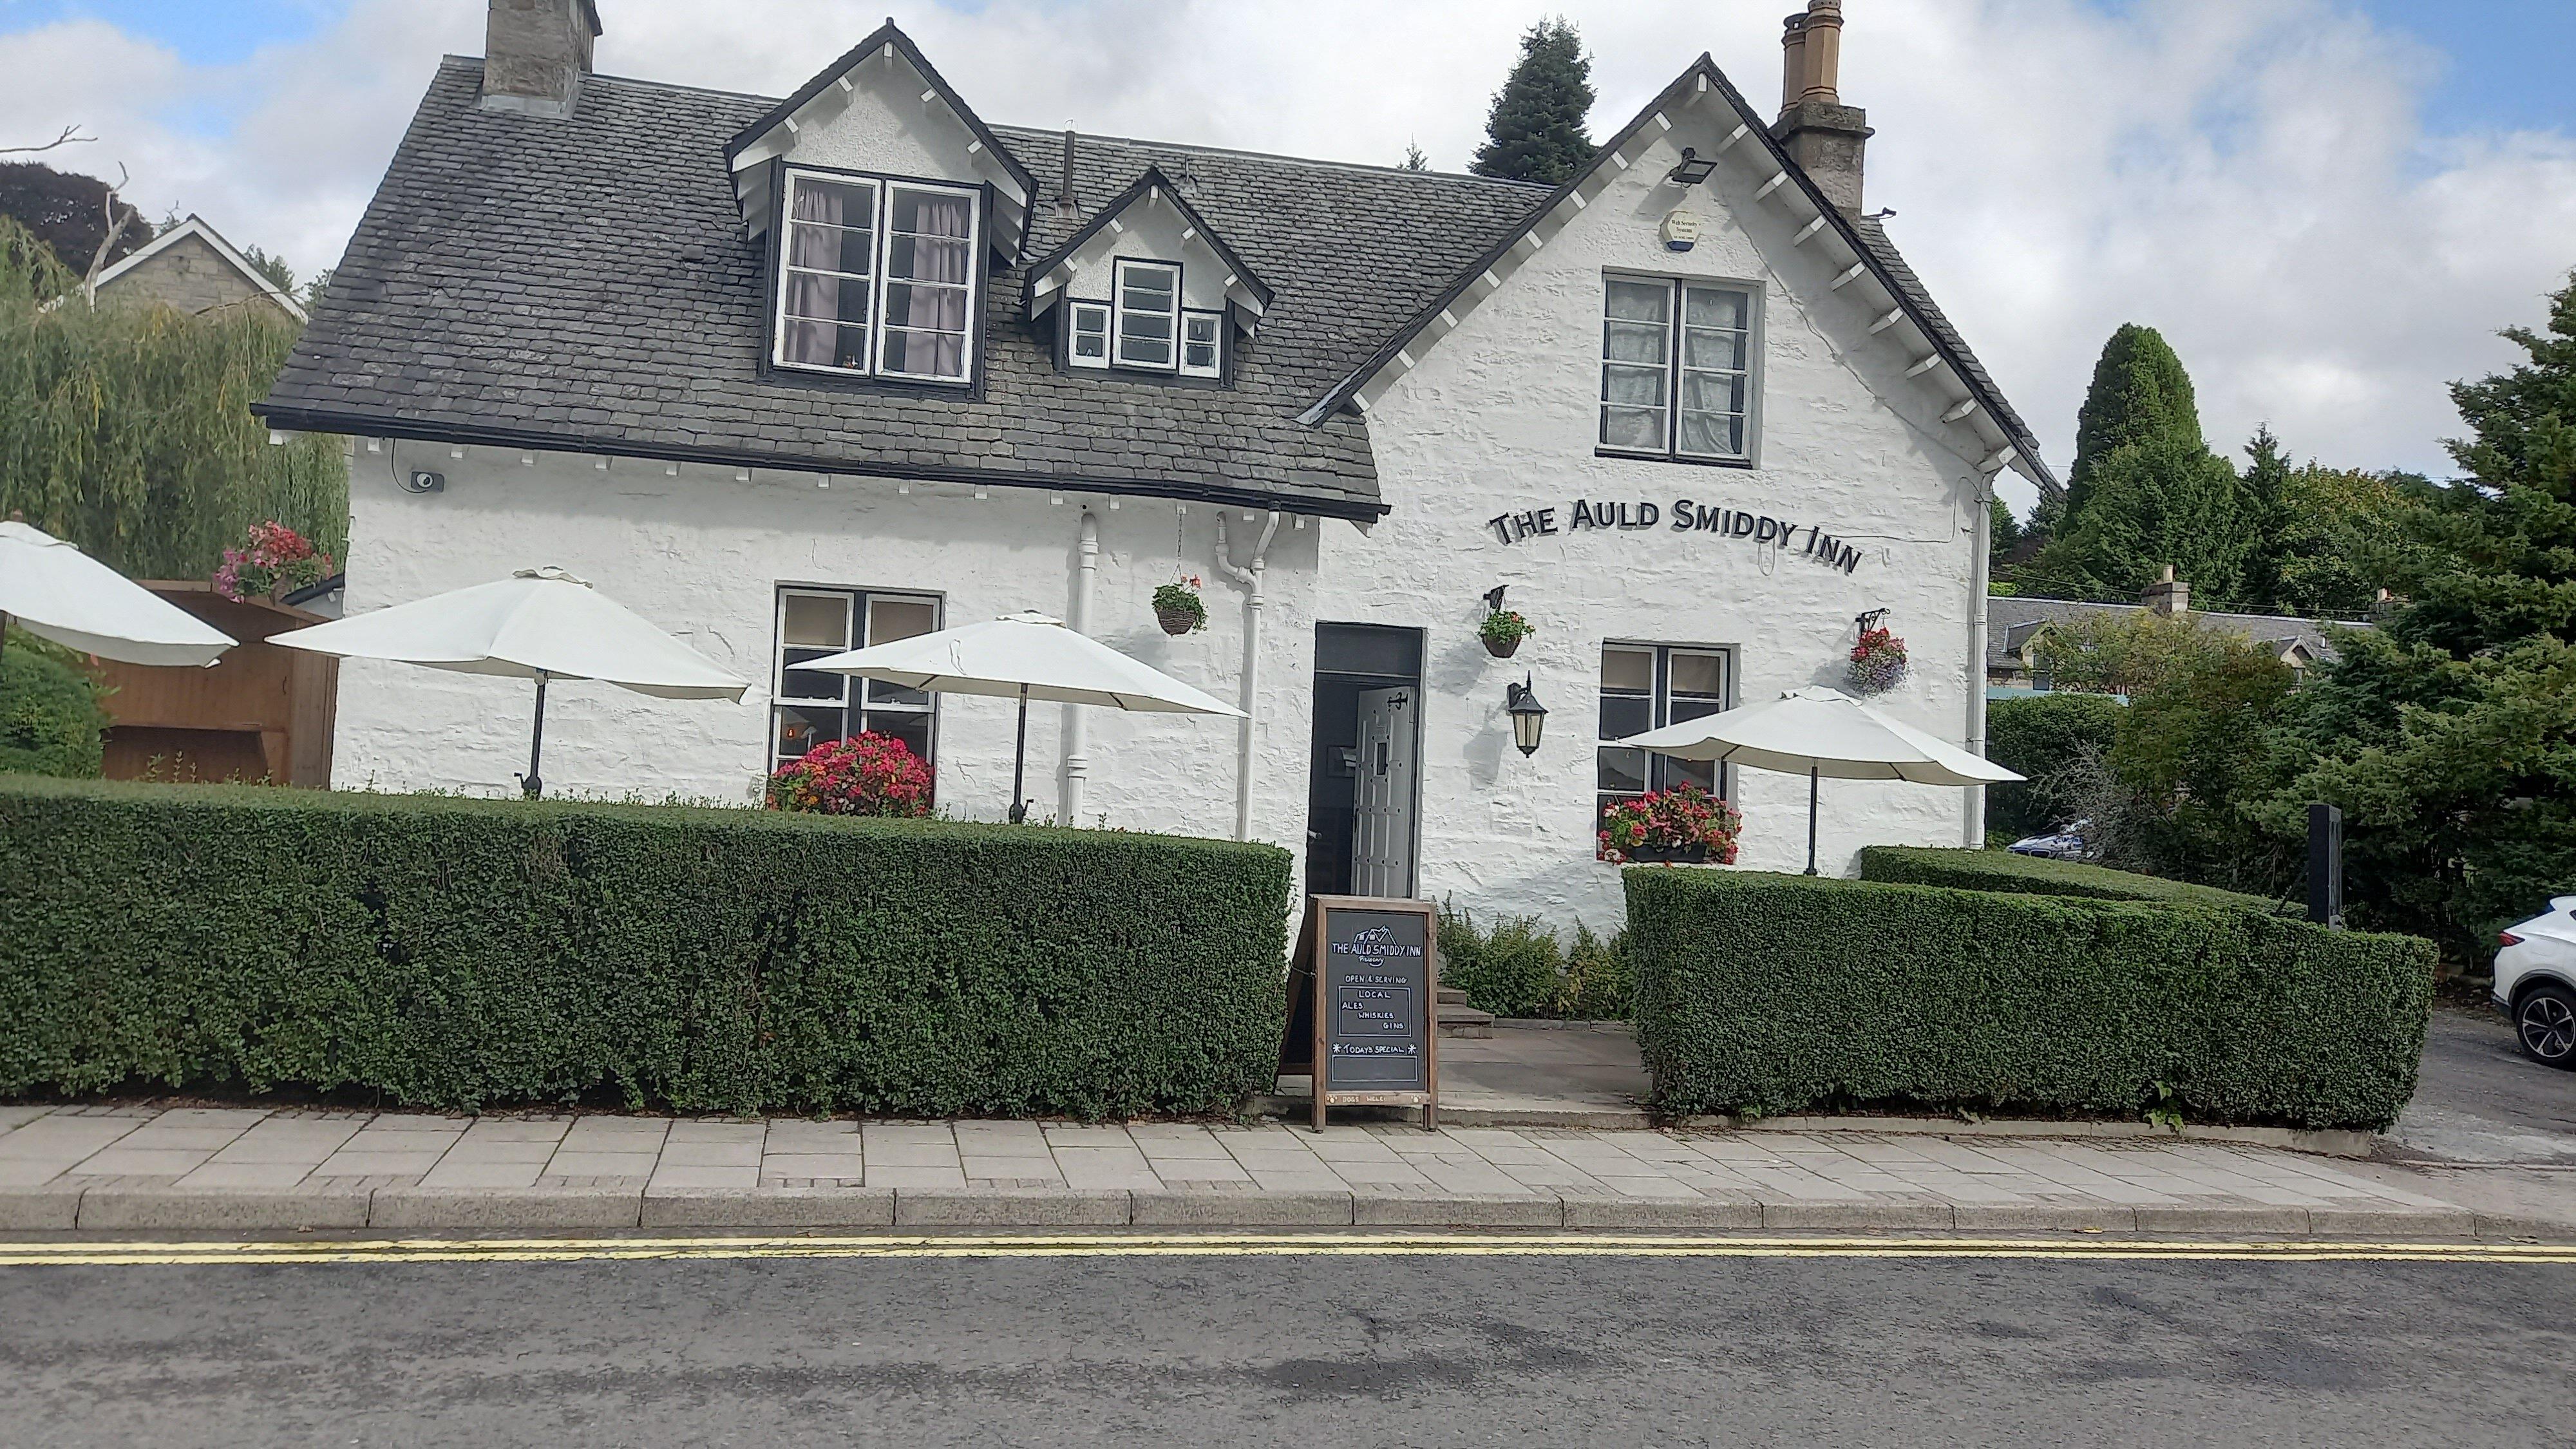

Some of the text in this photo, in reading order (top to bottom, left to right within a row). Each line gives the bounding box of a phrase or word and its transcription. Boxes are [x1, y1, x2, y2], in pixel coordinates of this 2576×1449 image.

[1332, 943, 1421, 956] THE AULD SMIDDY INN
[1345, 974, 1365, 983] OPEN
[1374, 974, 1408, 984] SERVING
[1358, 990, 1391, 999] LOCAL
[1341, 1001, 1363, 1010] ALES
[1374, 1045, 1405, 1054] SPECIAL
